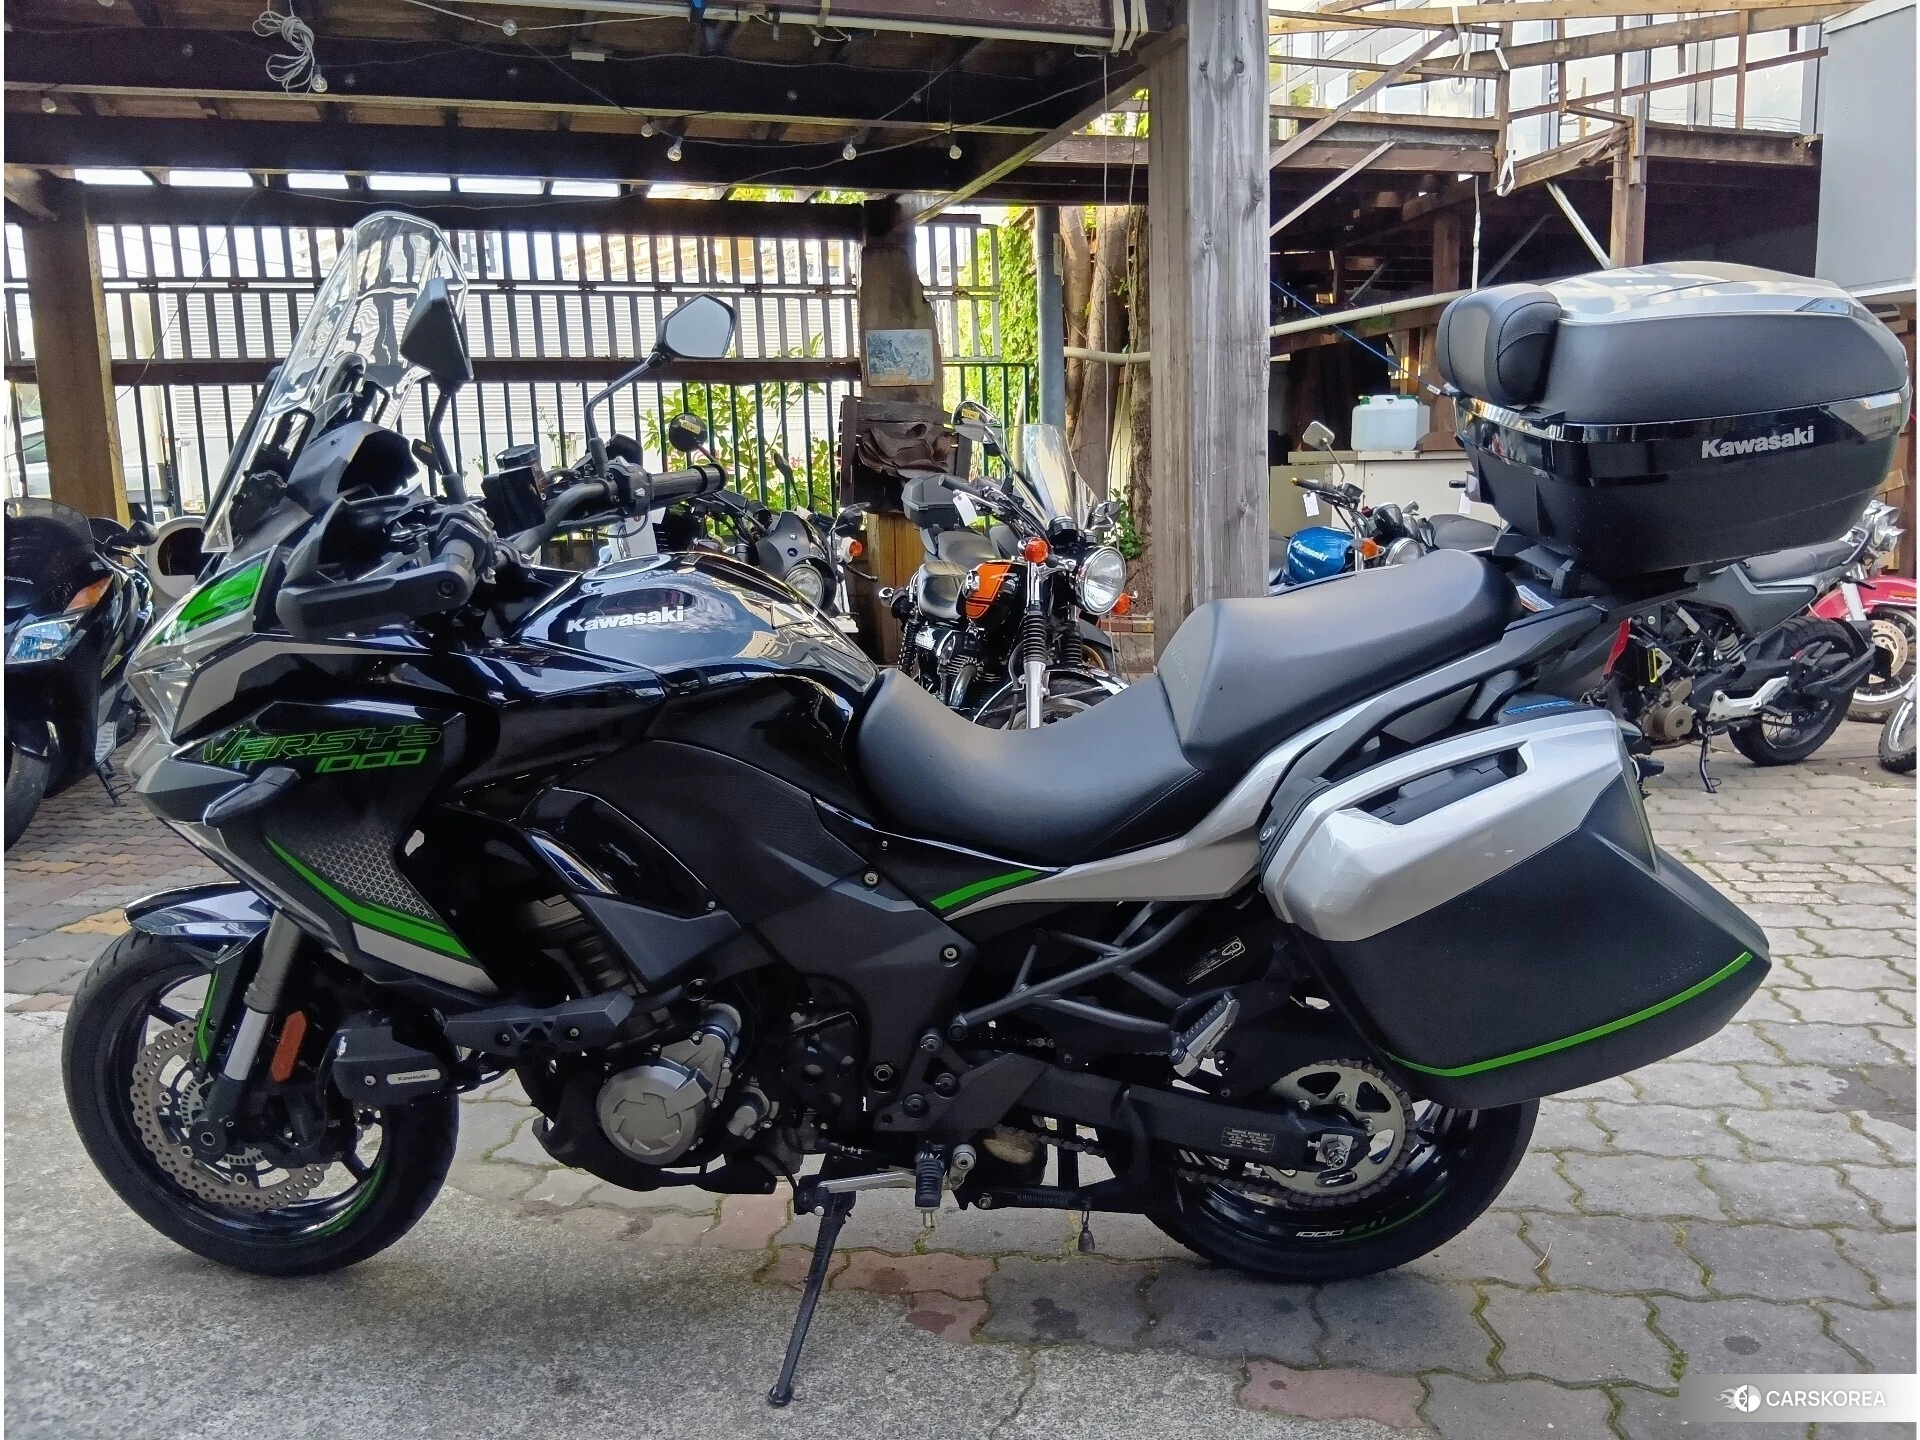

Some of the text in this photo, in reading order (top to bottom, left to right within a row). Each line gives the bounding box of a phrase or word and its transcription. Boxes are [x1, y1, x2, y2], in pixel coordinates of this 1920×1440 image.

[1701, 425, 1814, 459] Kawasaki
[1292, 540, 1329, 562] Kawasaki
[566, 605, 684, 633] Kawasaki
[203, 724, 442, 764] VERSYS
[314, 749, 427, 774] 1000
[397, 1073, 430, 1081] Kawasaki
[1295, 1229, 1345, 1238] 1000
